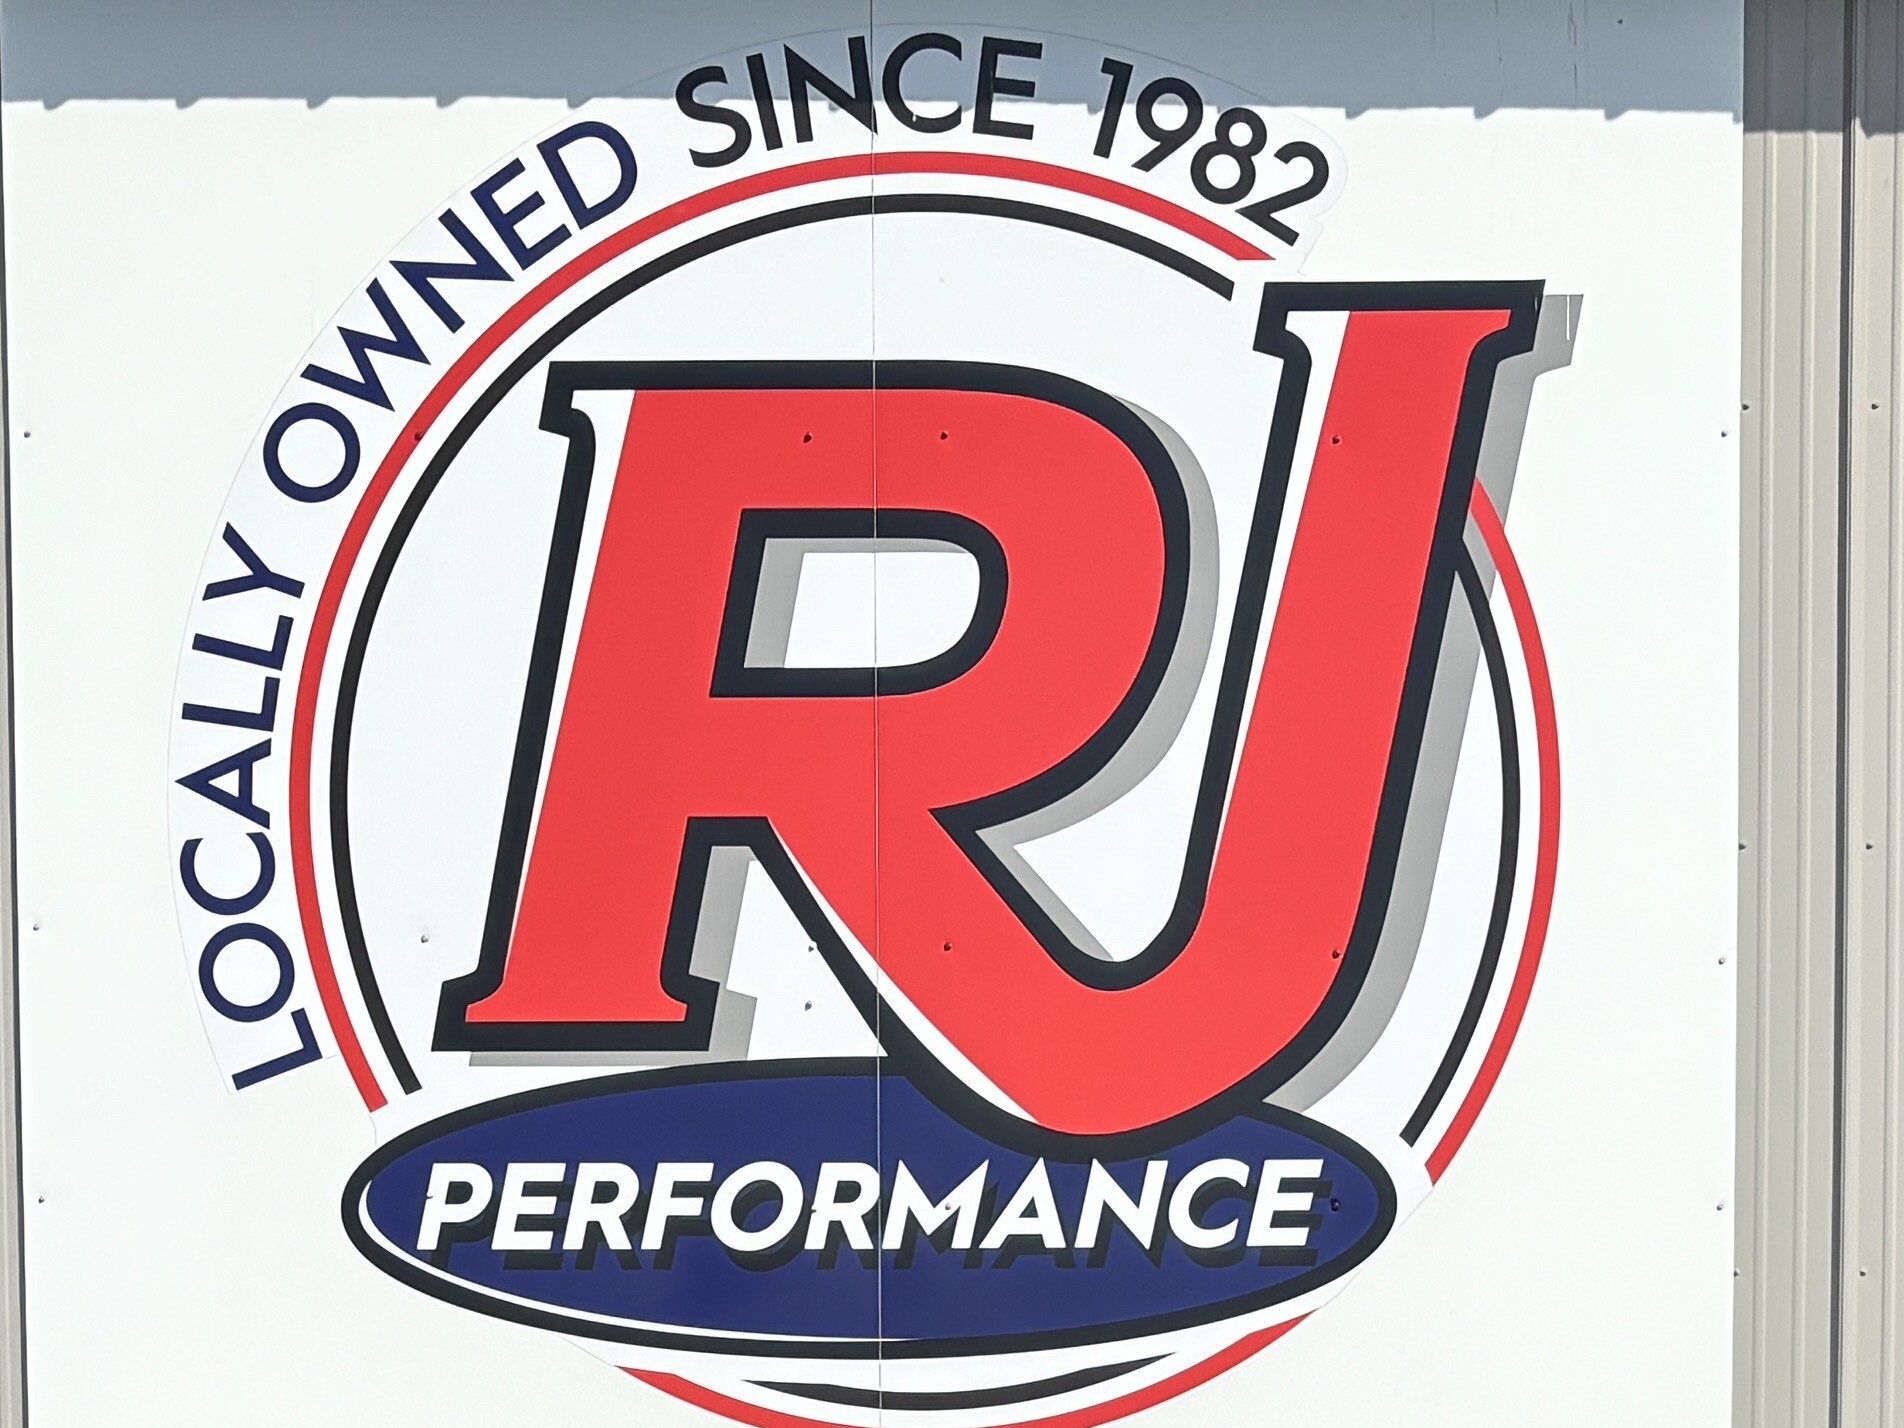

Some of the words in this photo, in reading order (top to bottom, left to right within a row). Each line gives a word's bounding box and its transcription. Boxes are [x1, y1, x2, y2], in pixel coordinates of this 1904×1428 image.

[177, 522, 322, 1090] LOCALLY
[263, 120, 639, 503] OWNED
[675, 34, 1042, 167] SINCE
[1094, 60, 1331, 246] 1982
[432, 278, 1546, 1162] RJ
[416, 1157, 1325, 1252] PERFORMANCE
